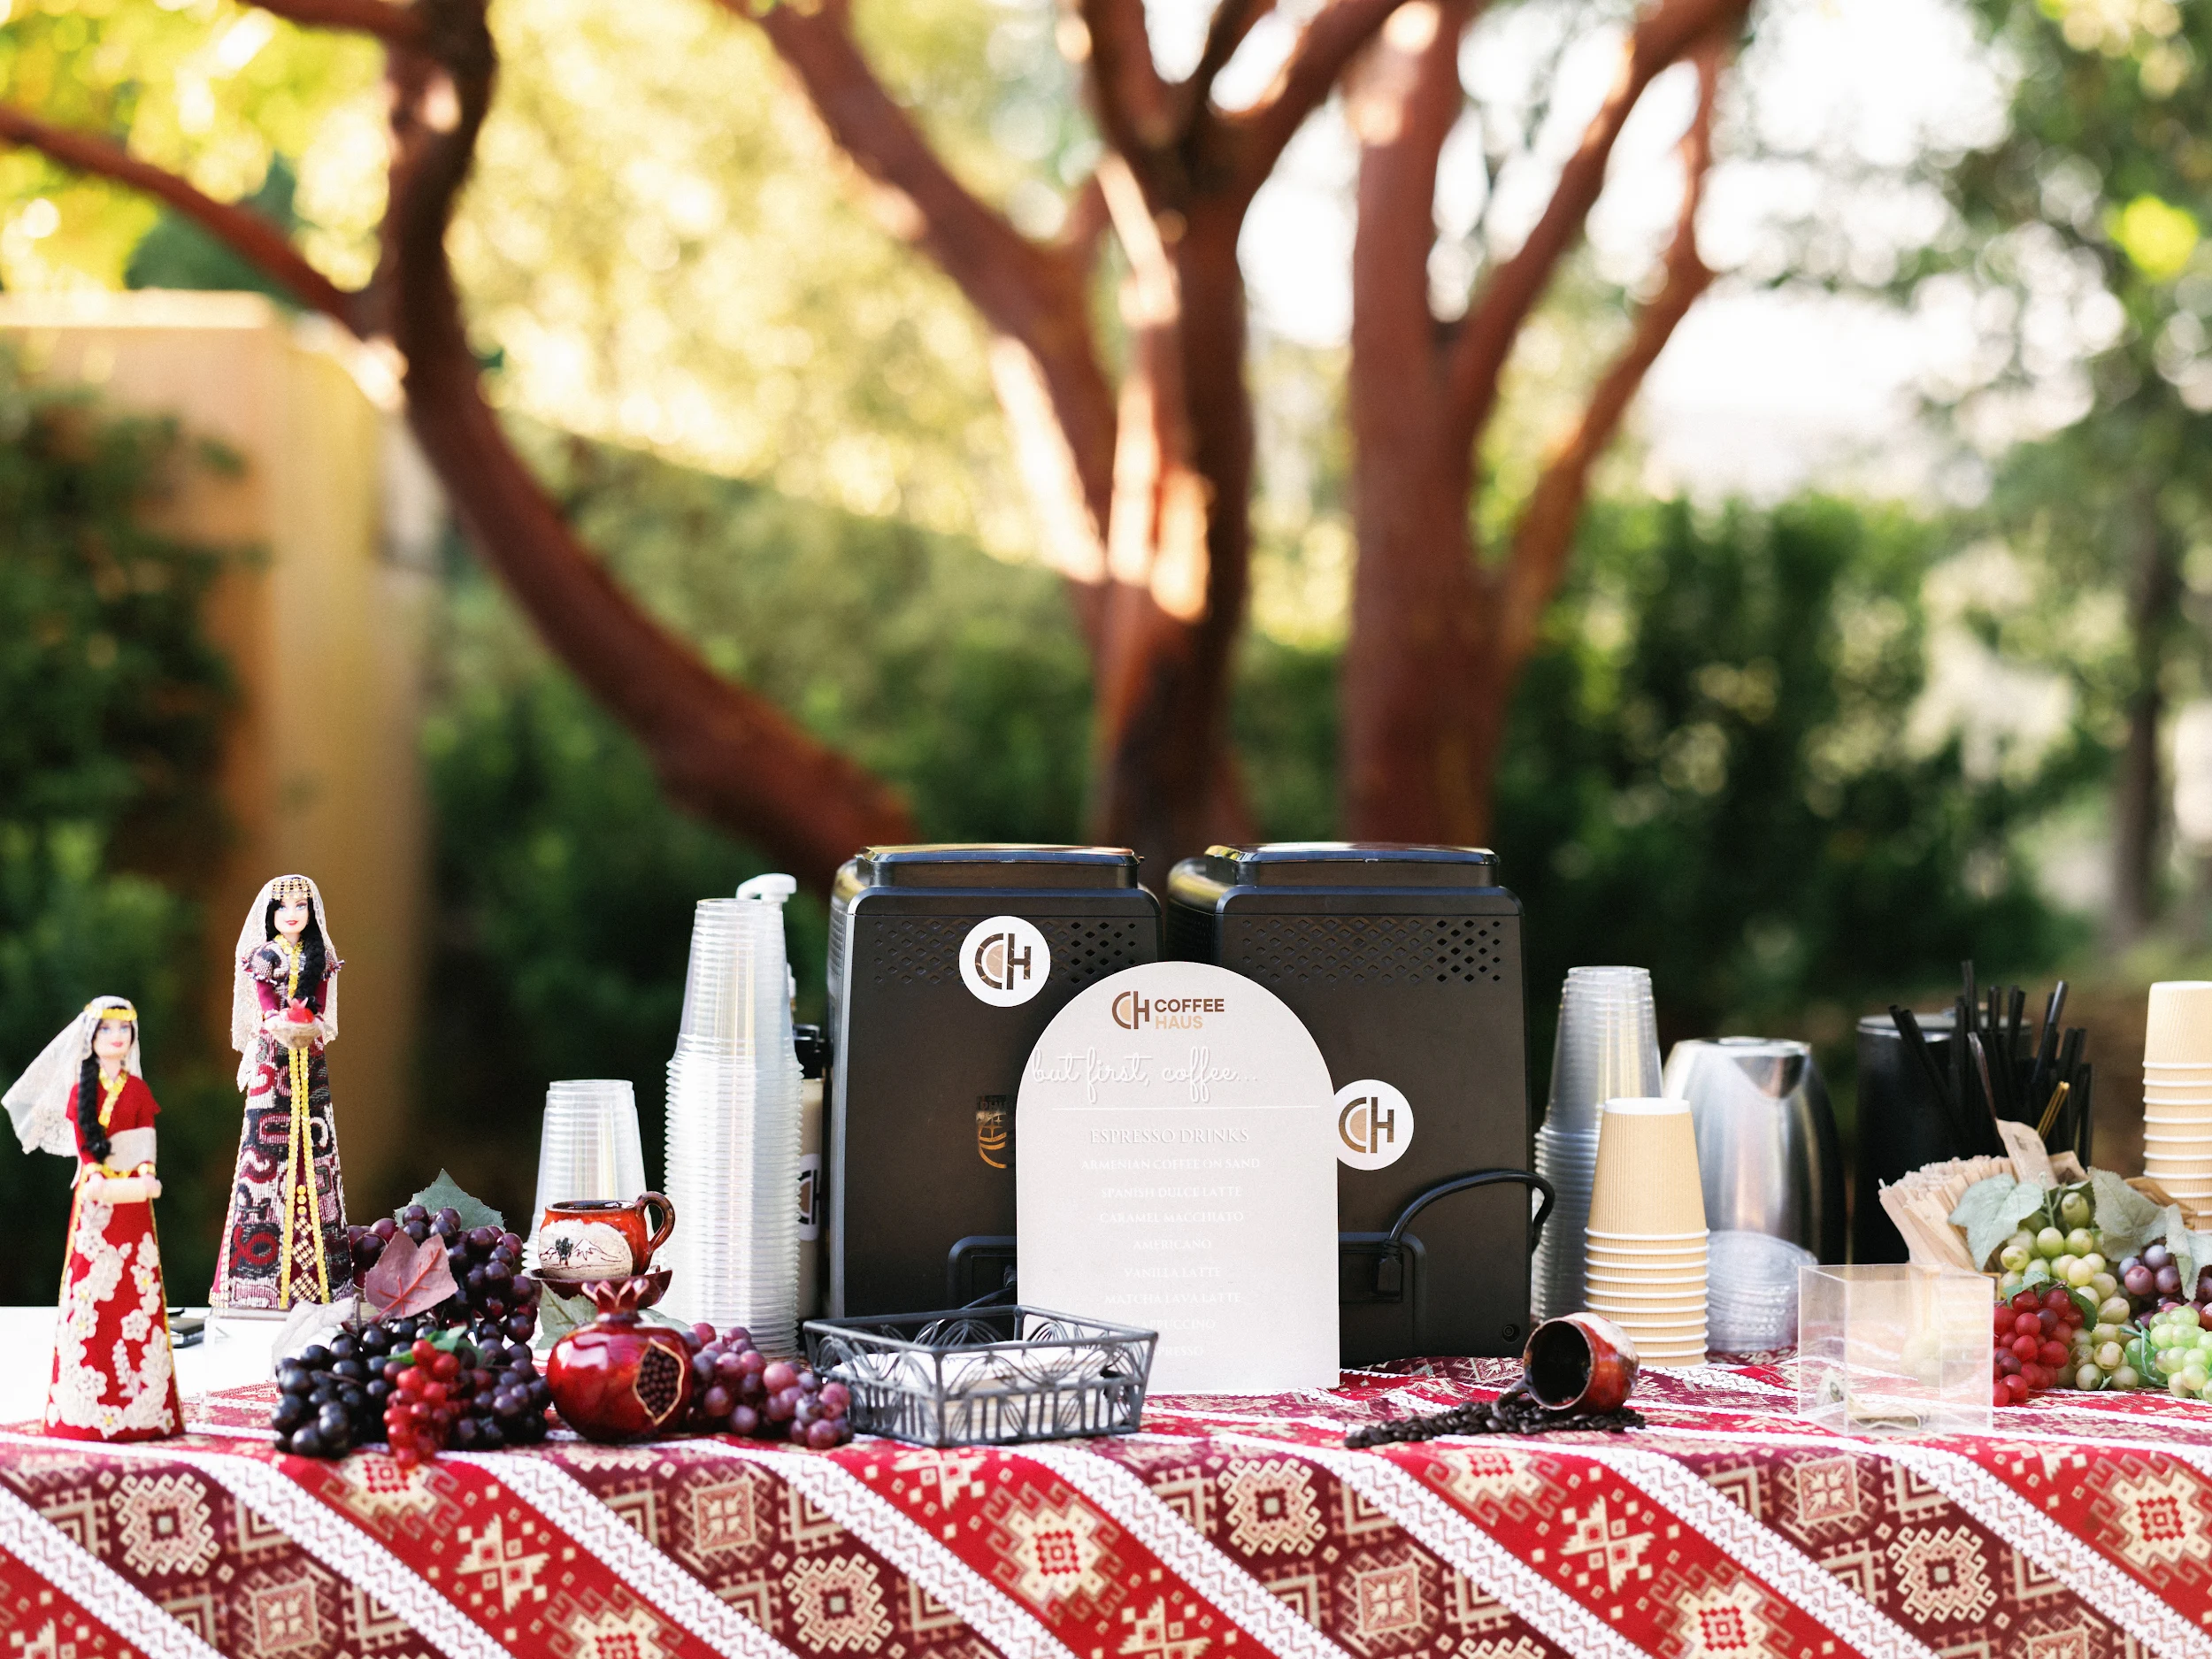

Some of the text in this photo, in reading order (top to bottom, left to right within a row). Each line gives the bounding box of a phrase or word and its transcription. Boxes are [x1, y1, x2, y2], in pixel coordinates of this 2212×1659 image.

[1155, 999, 1225, 1012] COFFEE
[1156, 1016, 1202, 1029] HAUS
[1032, 1048, 1087, 1083] but
[1087, 1047, 1153, 1104] first,
[1090, 1127, 1249, 1144] ESPRESSO DRINKS
[1081, 1157, 1260, 1170] ARMENIAN COFFEE ON SAND
[1102, 1186, 1242, 1198] SPANISH DULCE LATTE
[1100, 1211, 1244, 1223] CARAMEL MACCHIATO
[1133, 1239, 1211, 1249] AMERICANO
[1124, 1266, 1221, 1278] VANILLA LATTE
[1105, 1292, 1241, 1304] MATCHA LAVA LATTE
